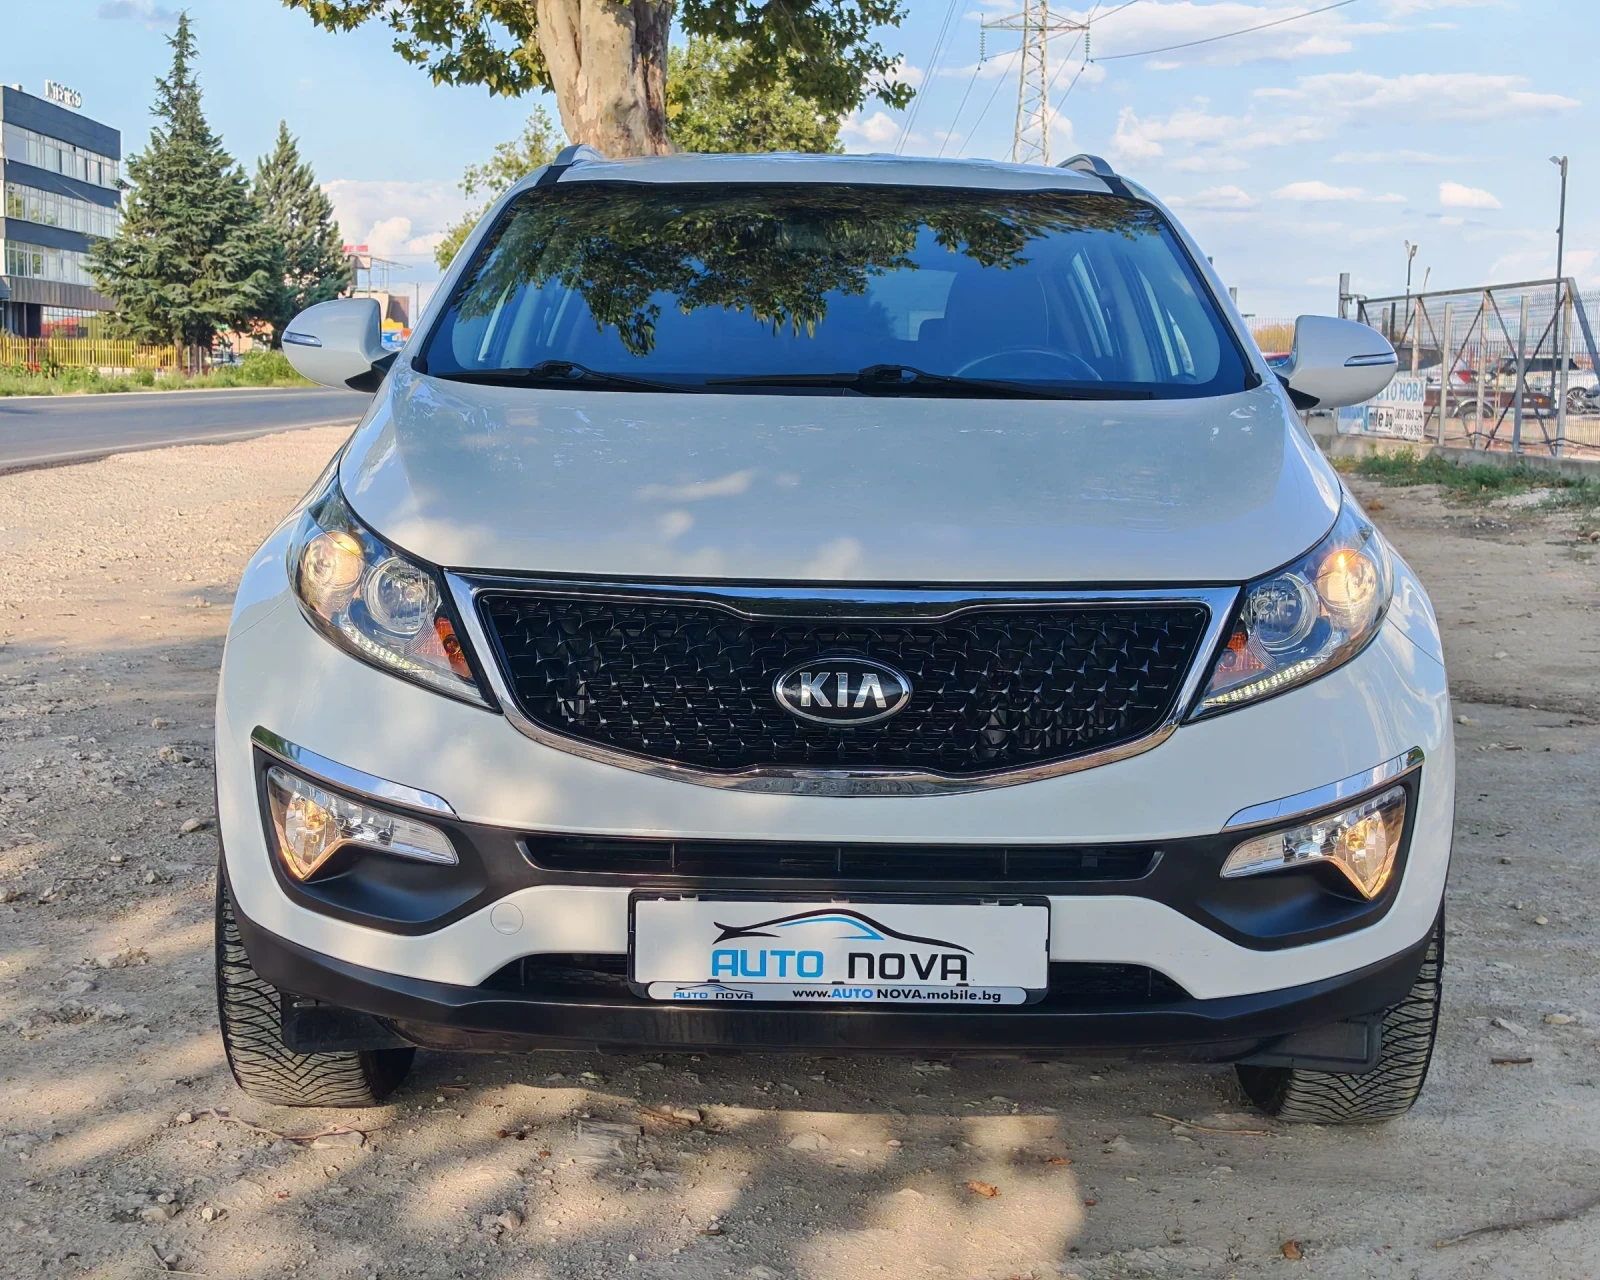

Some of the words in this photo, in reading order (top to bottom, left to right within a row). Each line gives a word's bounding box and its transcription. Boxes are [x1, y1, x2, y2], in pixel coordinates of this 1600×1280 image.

[799, 672, 887, 708] KIA
[711, 949, 824, 978] AUTO
[848, 952, 967, 981] NOVA
[715, 992, 753, 1000] NOVA
